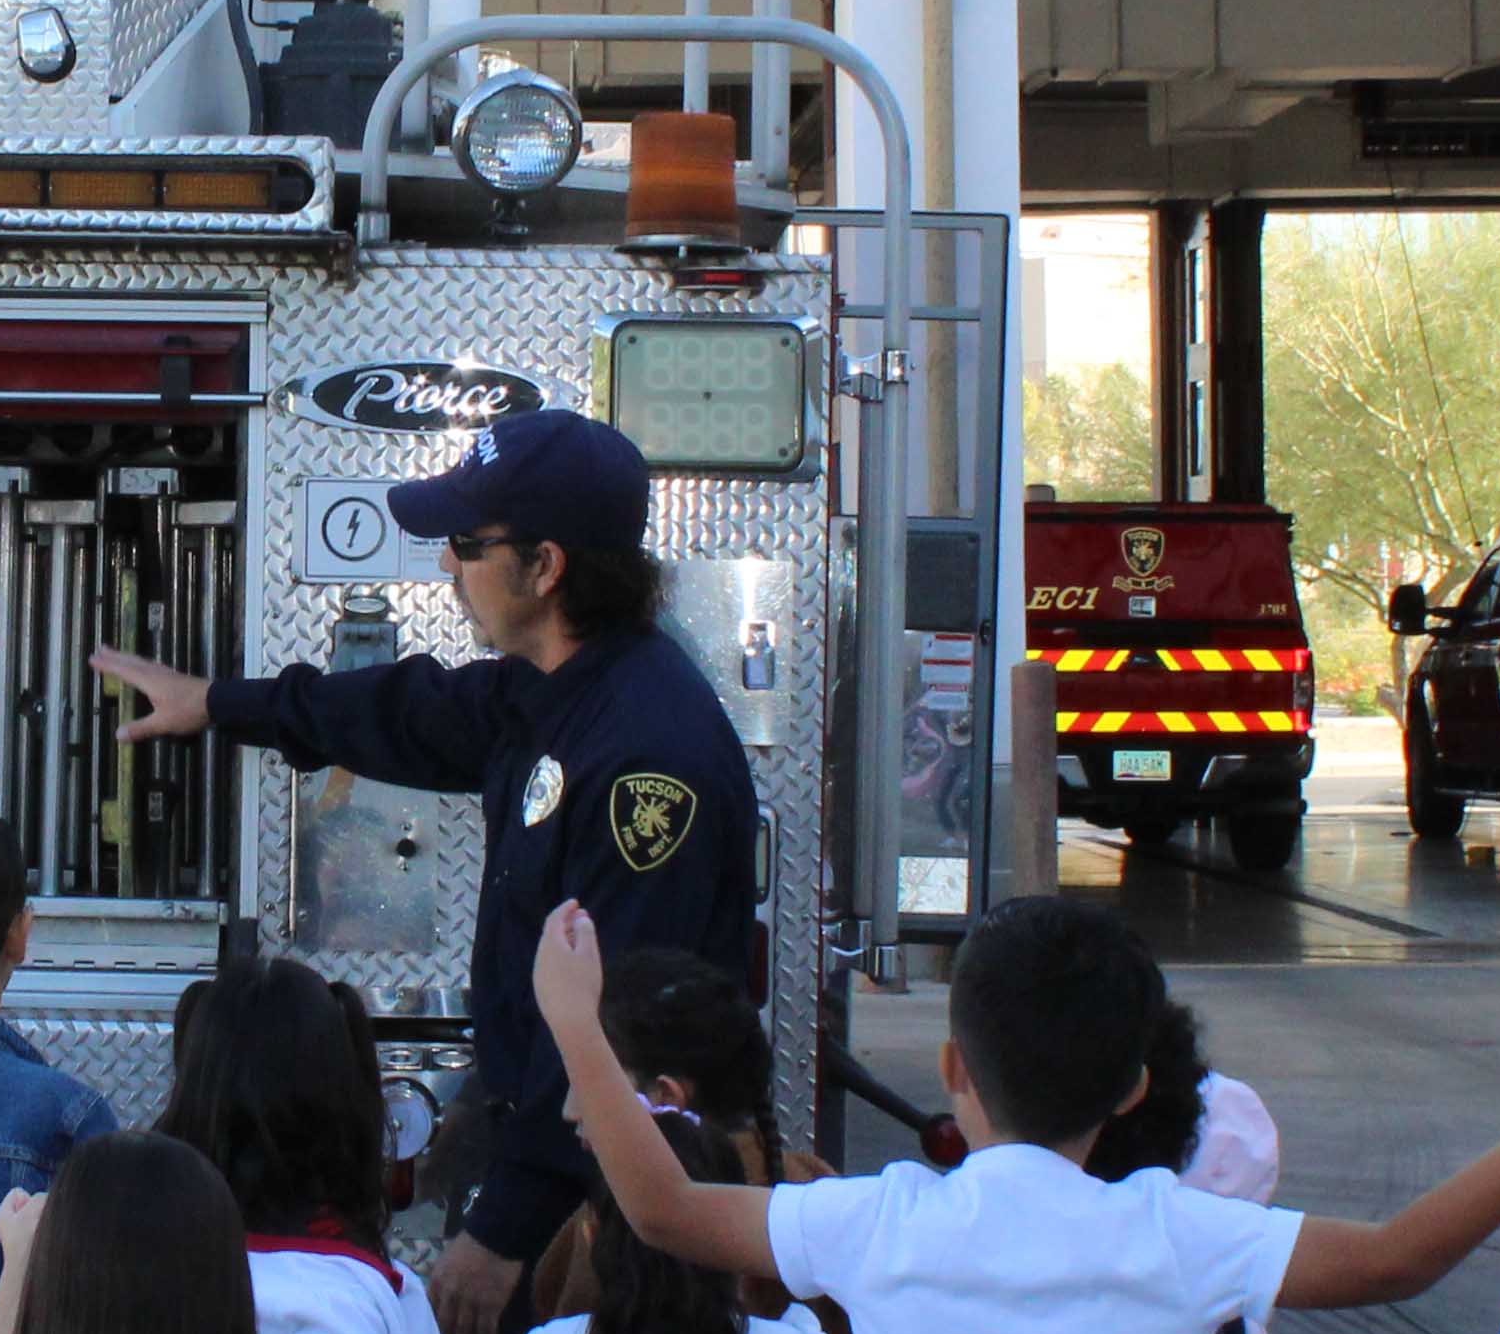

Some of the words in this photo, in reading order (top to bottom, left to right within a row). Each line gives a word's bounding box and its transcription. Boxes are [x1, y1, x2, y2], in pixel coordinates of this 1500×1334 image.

[342, 368, 511, 422] Pierce
[1025, 586, 1100, 610] EC1
[626, 780, 684, 803] TUCSON
